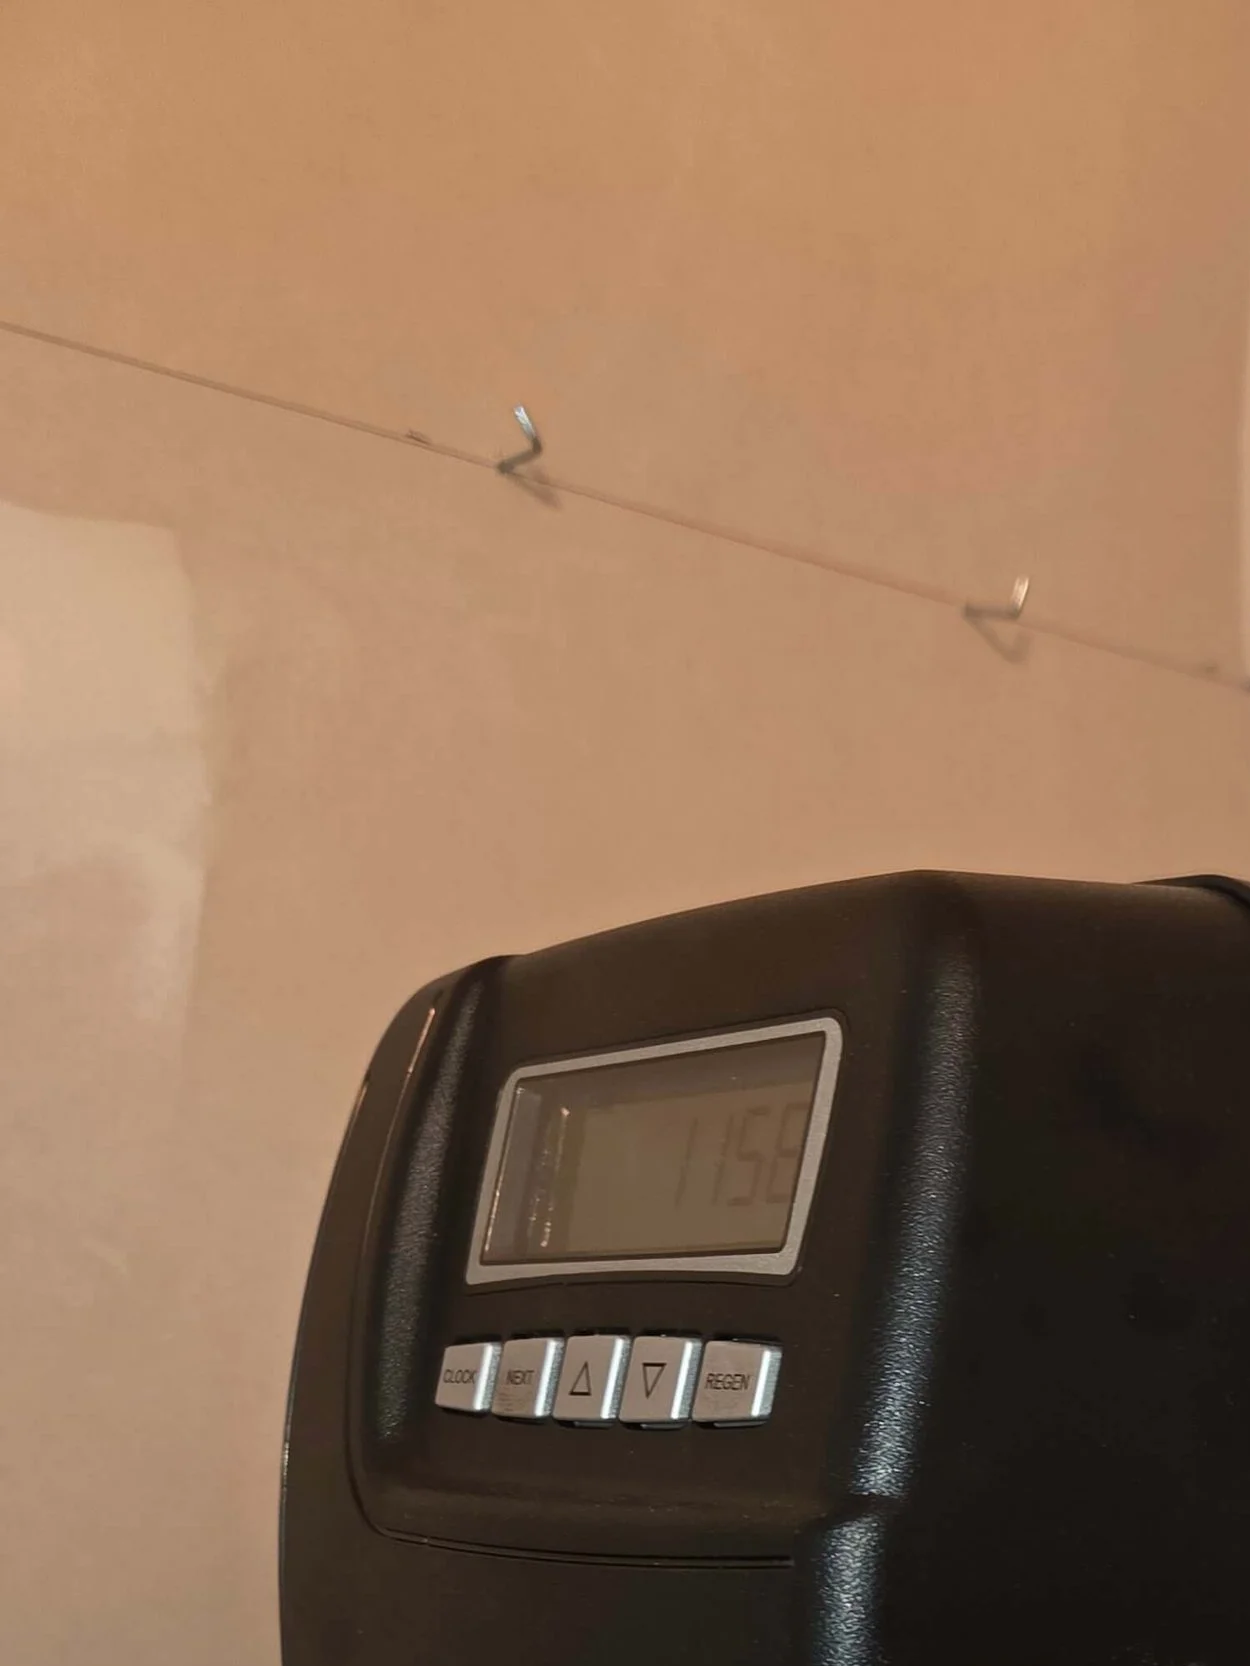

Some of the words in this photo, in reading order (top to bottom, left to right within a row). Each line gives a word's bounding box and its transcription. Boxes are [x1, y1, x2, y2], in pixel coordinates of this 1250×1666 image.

[443, 1368, 477, 1385] CLOCK
[504, 1368, 536, 1386] NEXT
[704, 1372, 750, 1391] REGEN
